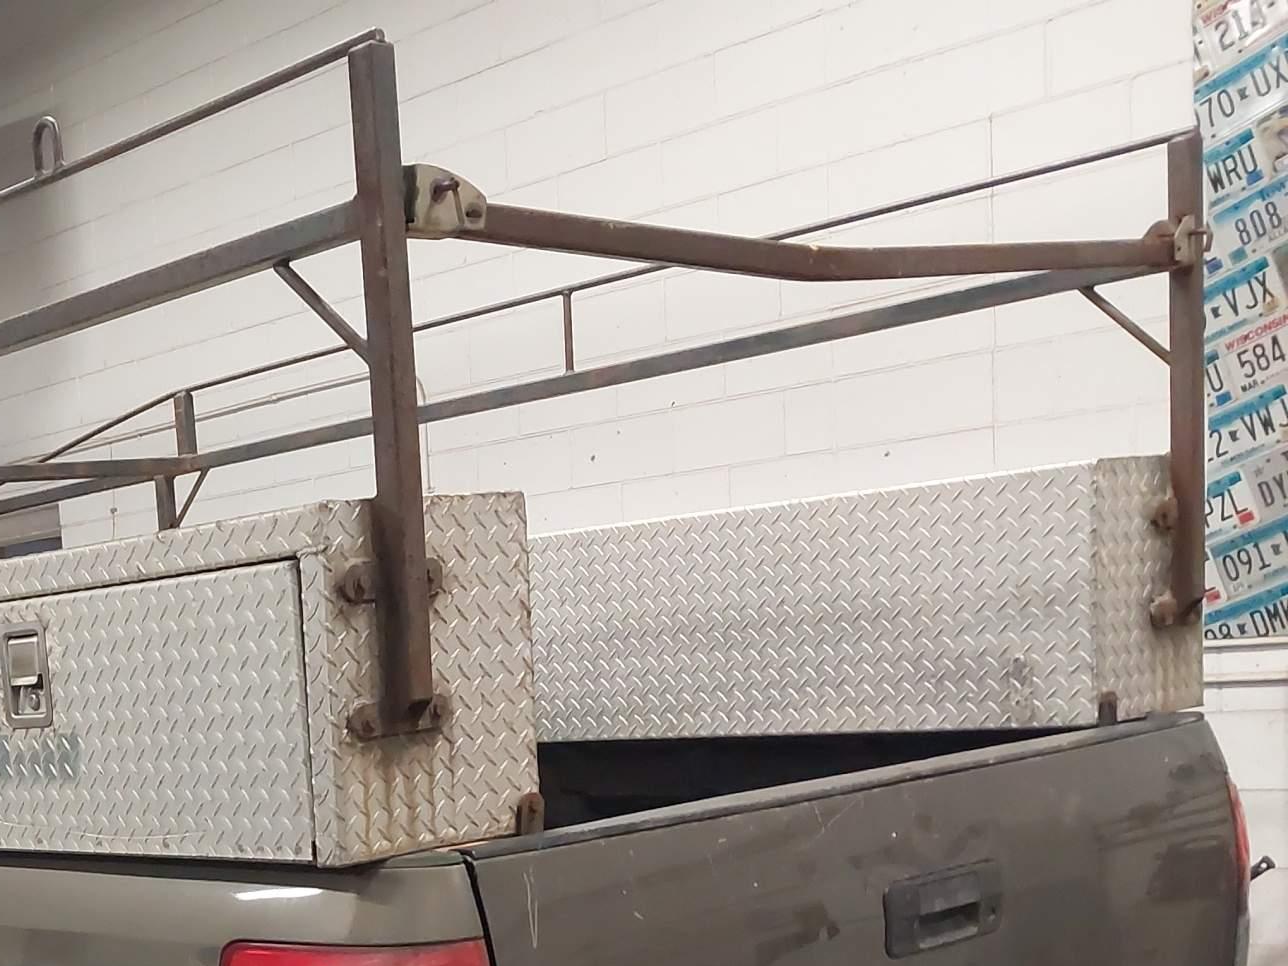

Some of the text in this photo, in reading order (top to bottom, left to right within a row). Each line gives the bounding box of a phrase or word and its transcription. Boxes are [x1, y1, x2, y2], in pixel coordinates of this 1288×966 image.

[1206, 143, 1258, 193] WRU
[1235, 201, 1282, 246] 808
[1222, 271, 1275, 317] VJX
[1237, 334, 1286, 379] 584
[1222, 542, 1272, 582] 091
